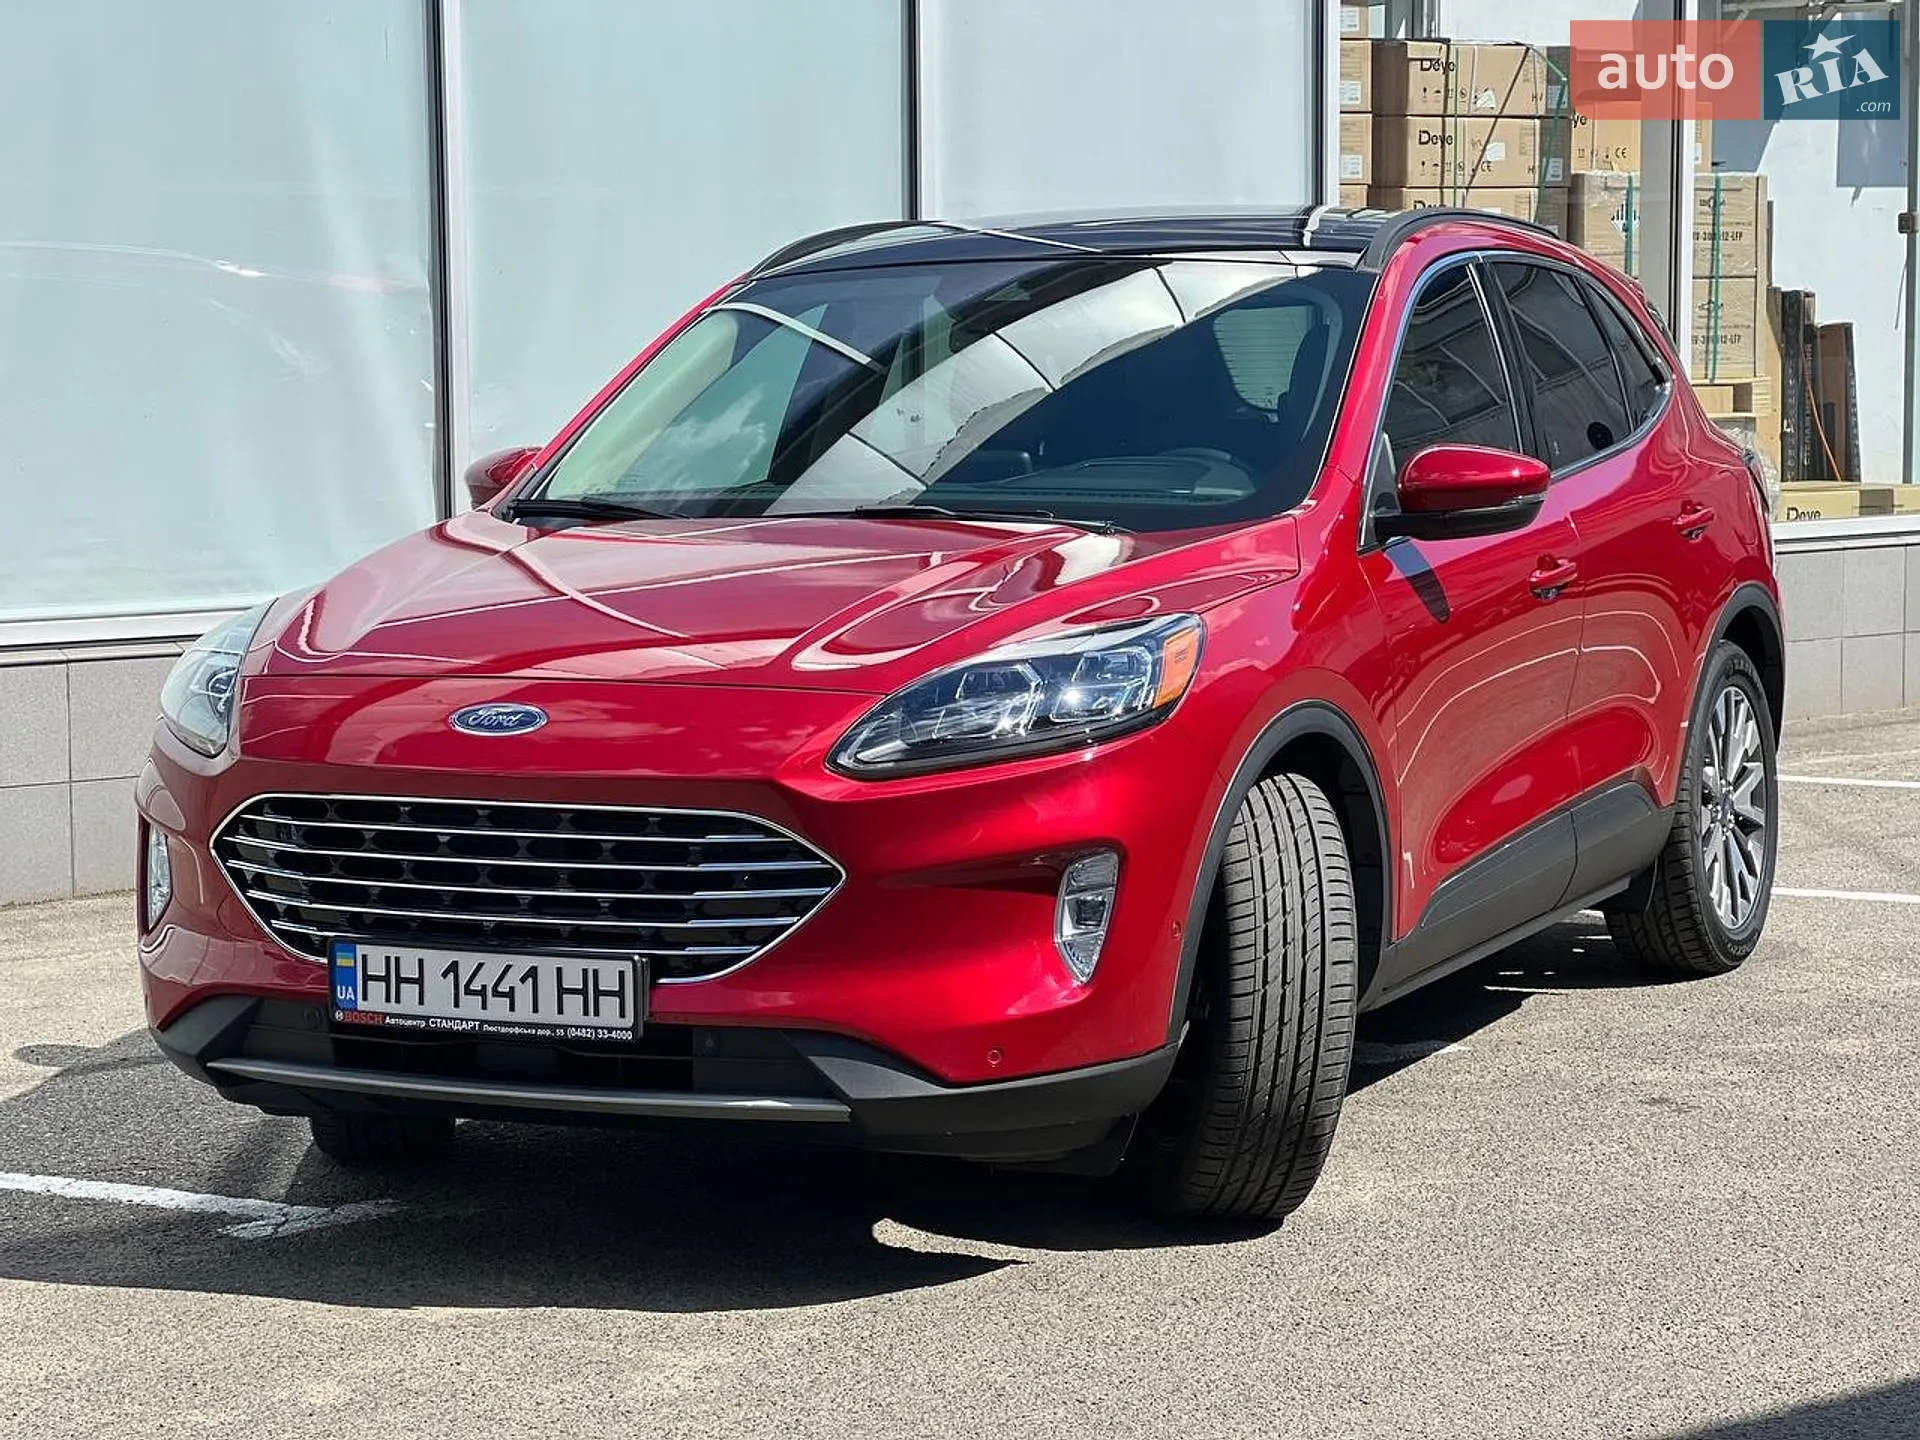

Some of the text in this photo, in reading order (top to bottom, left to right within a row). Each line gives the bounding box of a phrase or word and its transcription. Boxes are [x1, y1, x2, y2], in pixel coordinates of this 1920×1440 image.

[468, 707, 525, 728] Ford
[336, 985, 355, 1000] UA
[361, 953, 626, 1019] HH 1441 HH
[344, 1011, 385, 1024] BOSCH
[428, 1018, 481, 1031] СТАНДАРТ
[596, 1029, 633, 1040] 33-4000
